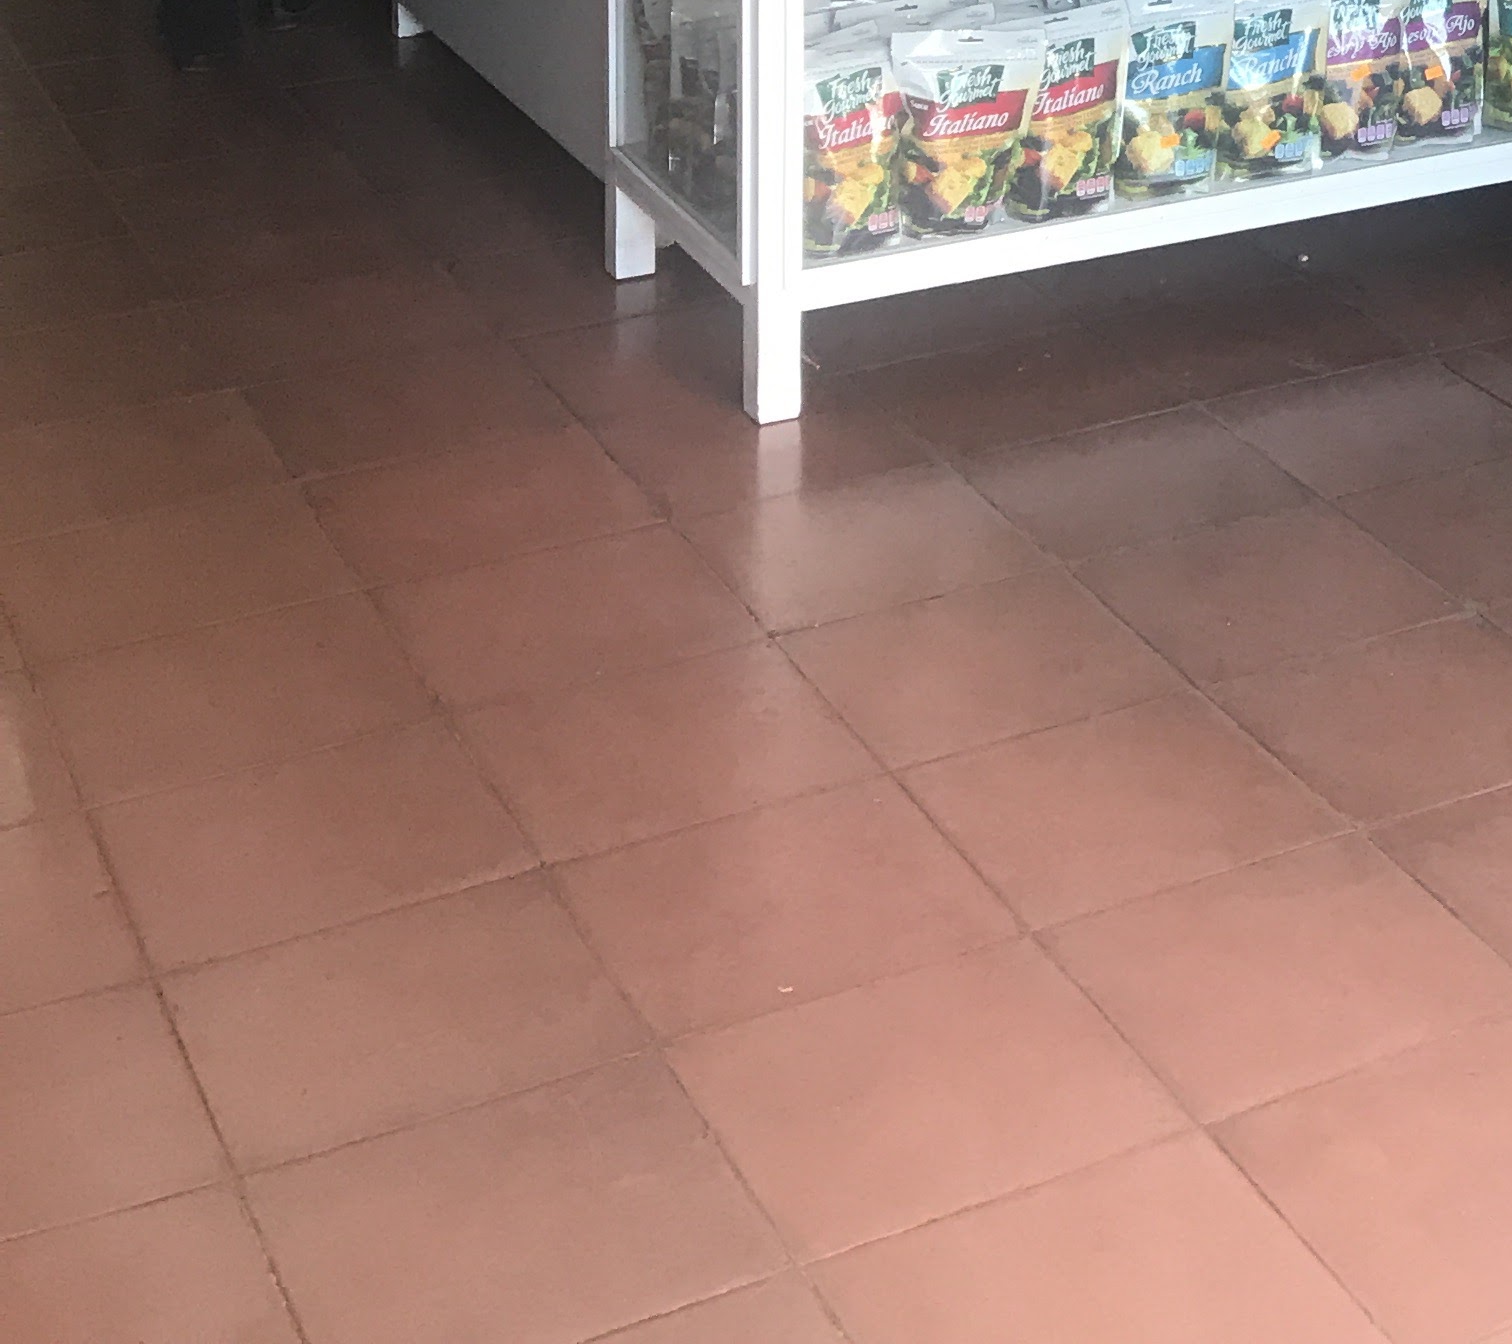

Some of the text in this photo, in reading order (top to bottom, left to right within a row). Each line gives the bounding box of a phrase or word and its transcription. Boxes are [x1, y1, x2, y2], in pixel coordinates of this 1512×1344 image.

[949, 68, 996, 98] Fresh
[1131, 63, 1203, 96] Ranch
[1033, 84, 1106, 118] Italiano
[923, 111, 1010, 140] Italiano
